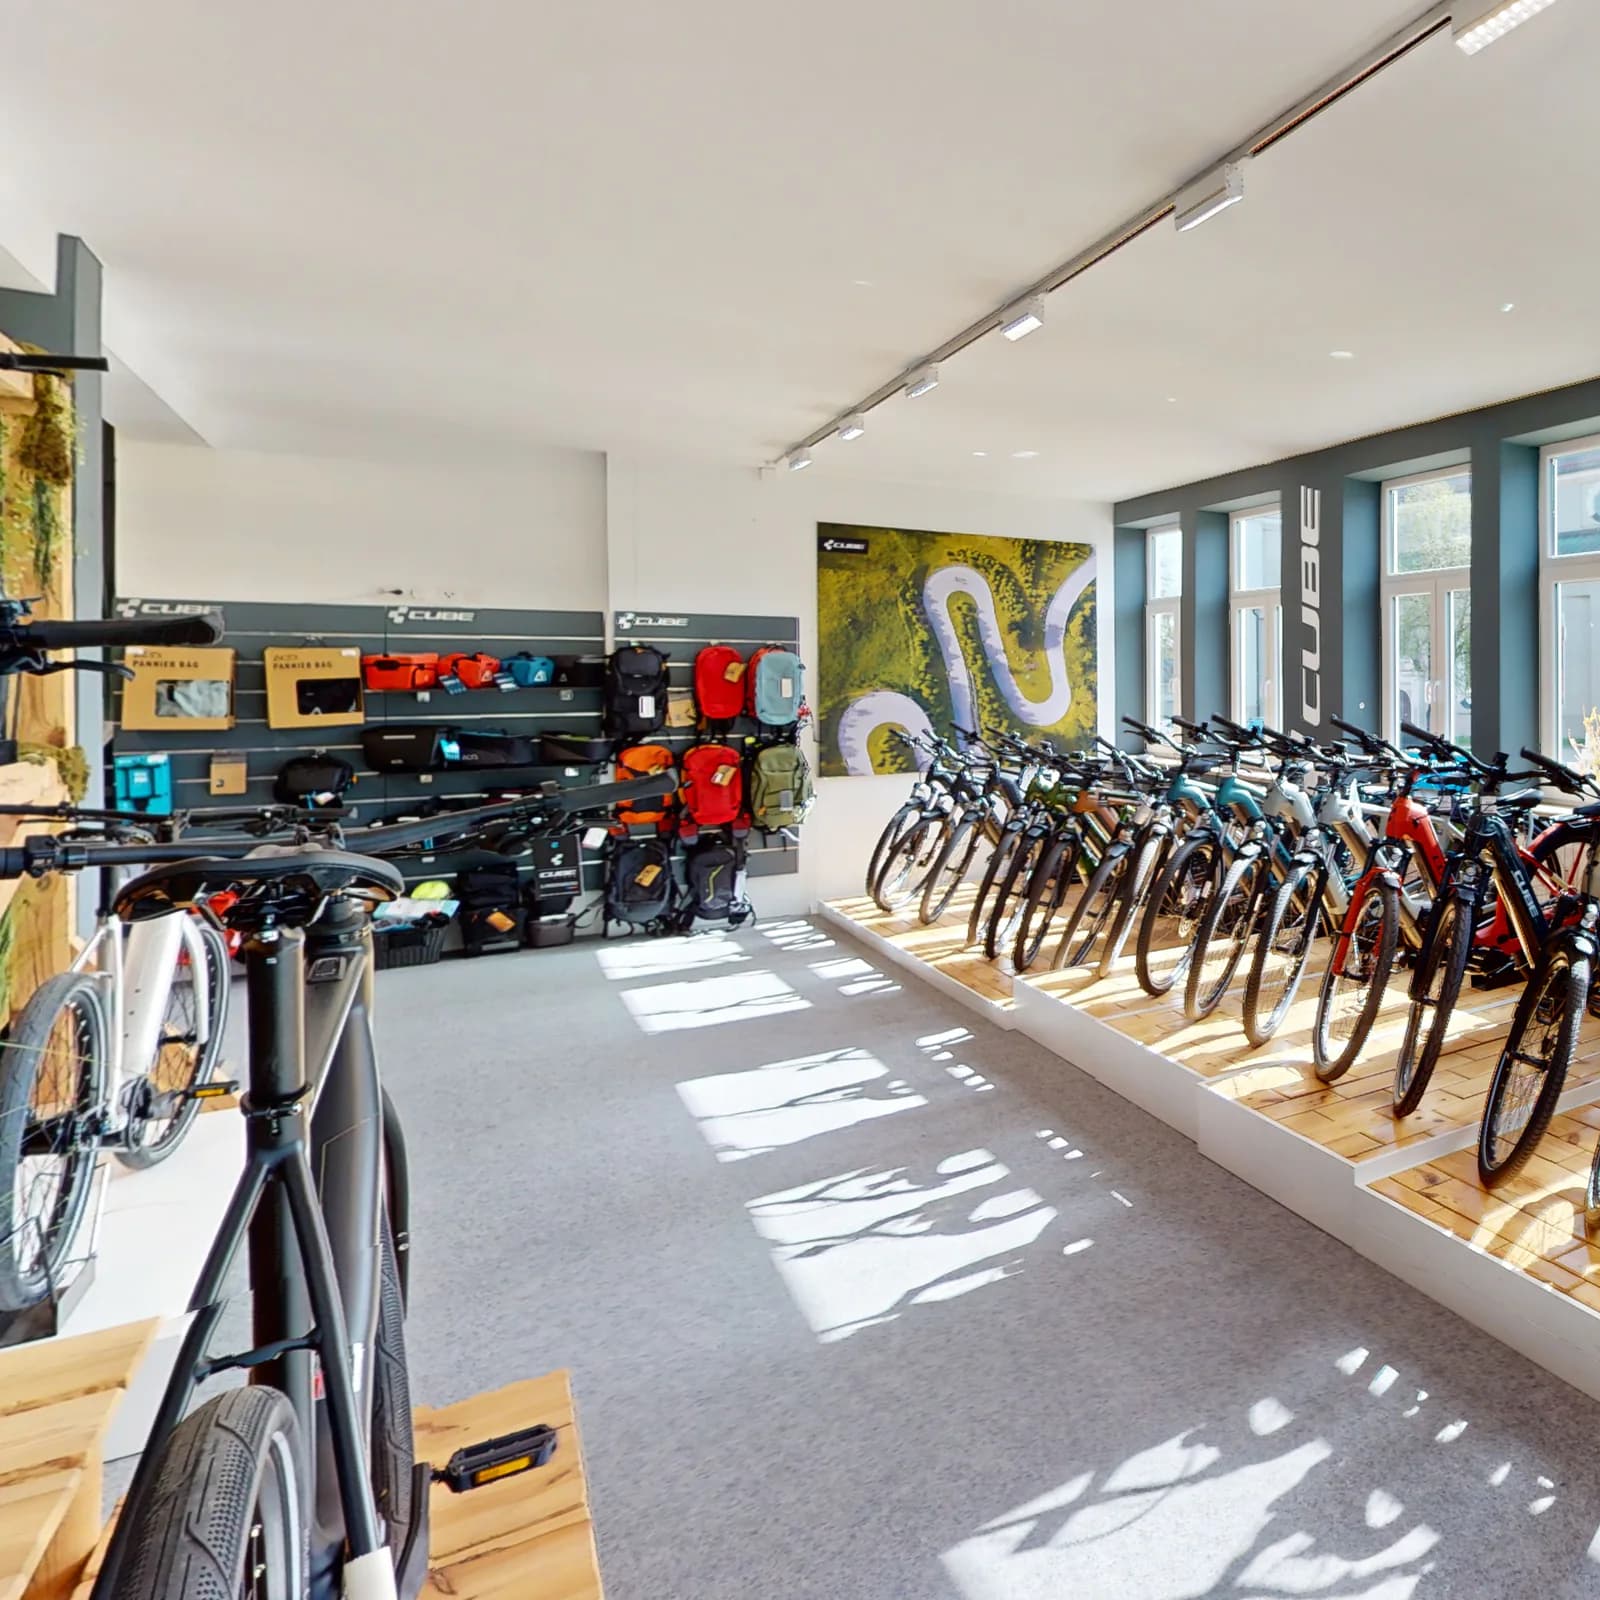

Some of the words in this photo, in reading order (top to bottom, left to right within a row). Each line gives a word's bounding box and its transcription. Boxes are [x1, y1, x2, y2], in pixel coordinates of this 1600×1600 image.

[1300, 484, 1320, 727] CUBE
[408, 610, 475, 622] CUBE
[635, 616, 689, 627] CUBE
[132, 661, 176, 669] PANNIER
[179, 661, 199, 669] BAG
[273, 662, 313, 671] PANNIER
[315, 661, 333, 669] BAG
[539, 869, 577, 878] CUBE
[1511, 869, 1539, 917] CUBE
